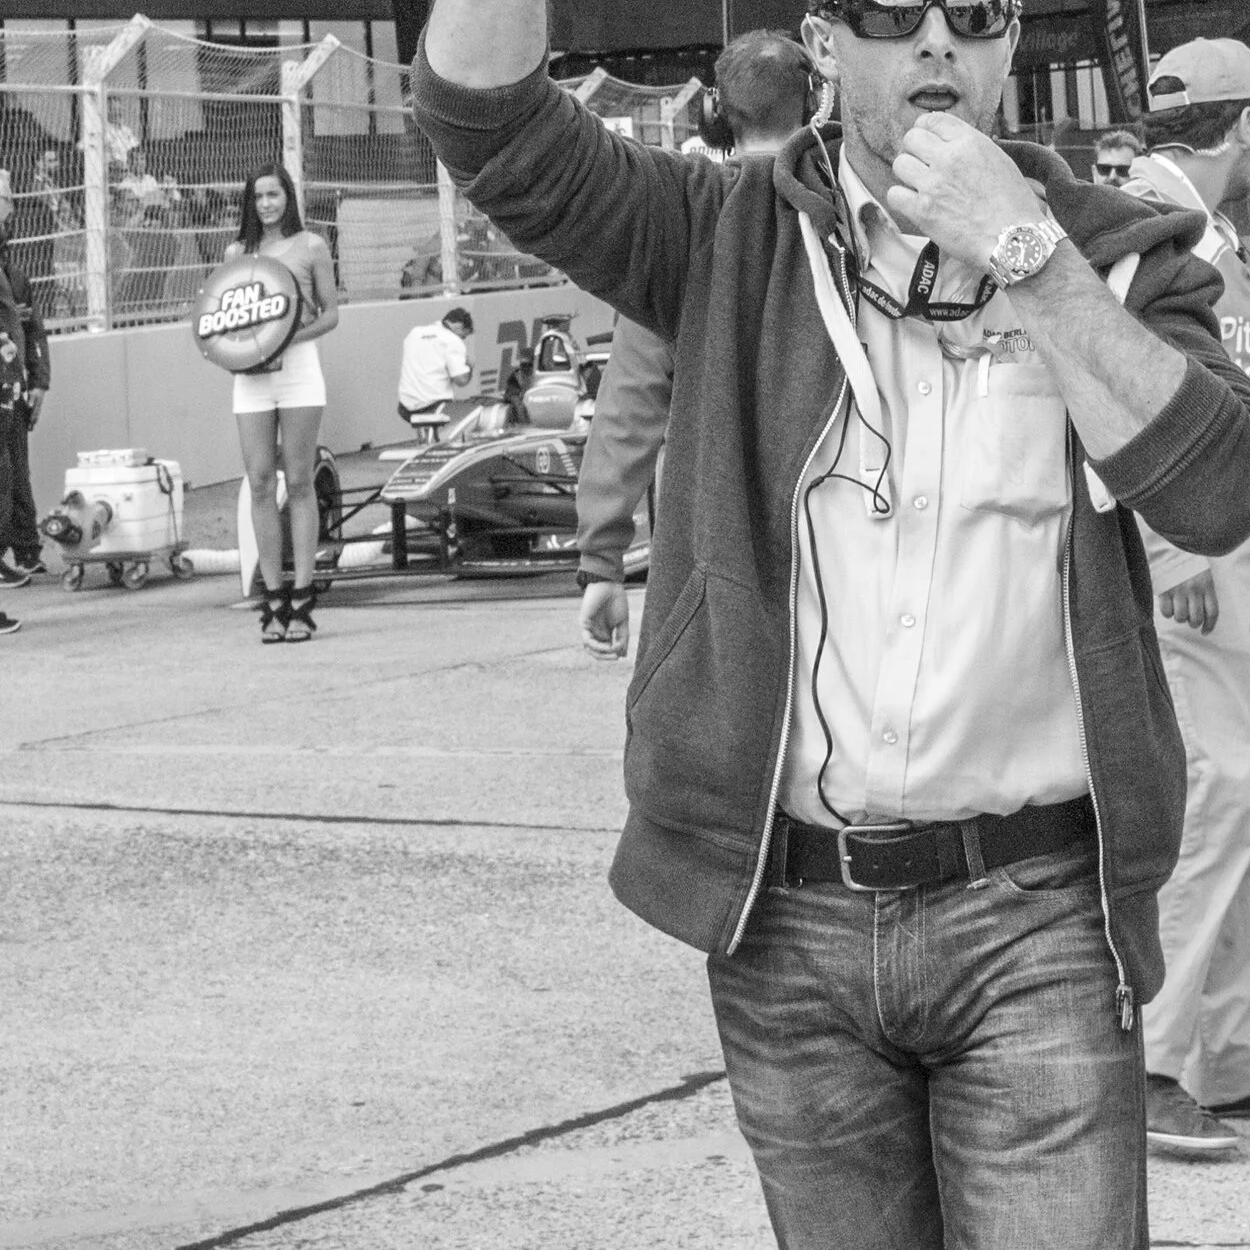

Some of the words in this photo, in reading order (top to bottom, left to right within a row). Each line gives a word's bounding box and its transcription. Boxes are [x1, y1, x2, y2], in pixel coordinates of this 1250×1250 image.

[917, 260, 936, 294] ADAC
[221, 282, 261, 311] FAN
[198, 294, 286, 336] BOOSTED
